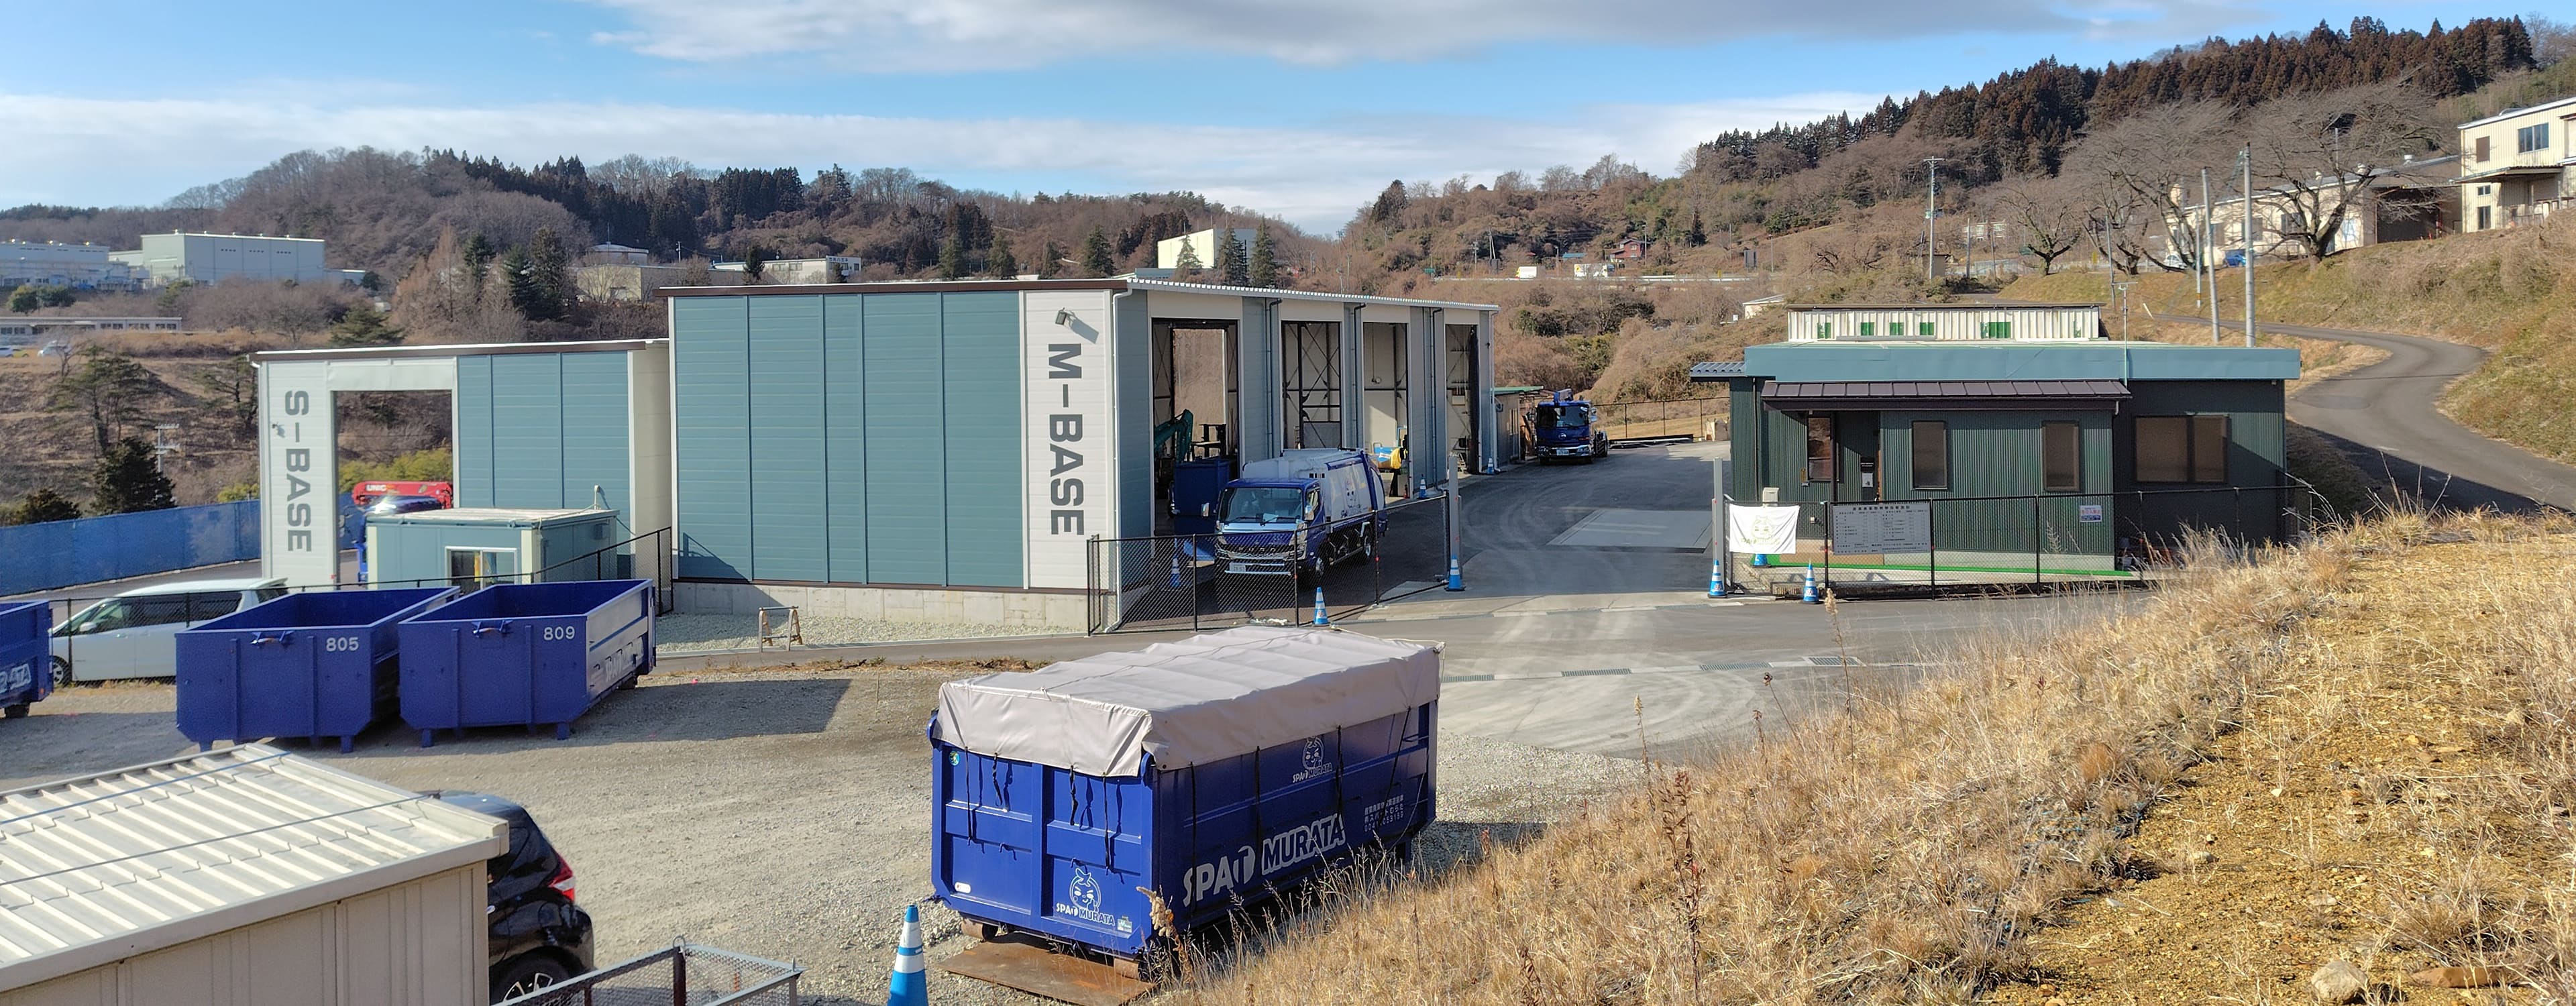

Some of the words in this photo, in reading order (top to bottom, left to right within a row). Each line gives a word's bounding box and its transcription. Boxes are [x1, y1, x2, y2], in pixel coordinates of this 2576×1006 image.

[1048, 343, 1085, 536] M-BASE
[284, 390, 312, 552] S-BASE
[325, 637, 360, 651] 805
[543, 626, 576, 640] 809
[1261, 813, 1346, 876] MURATA
[1079, 907, 1116, 926] MURATA
